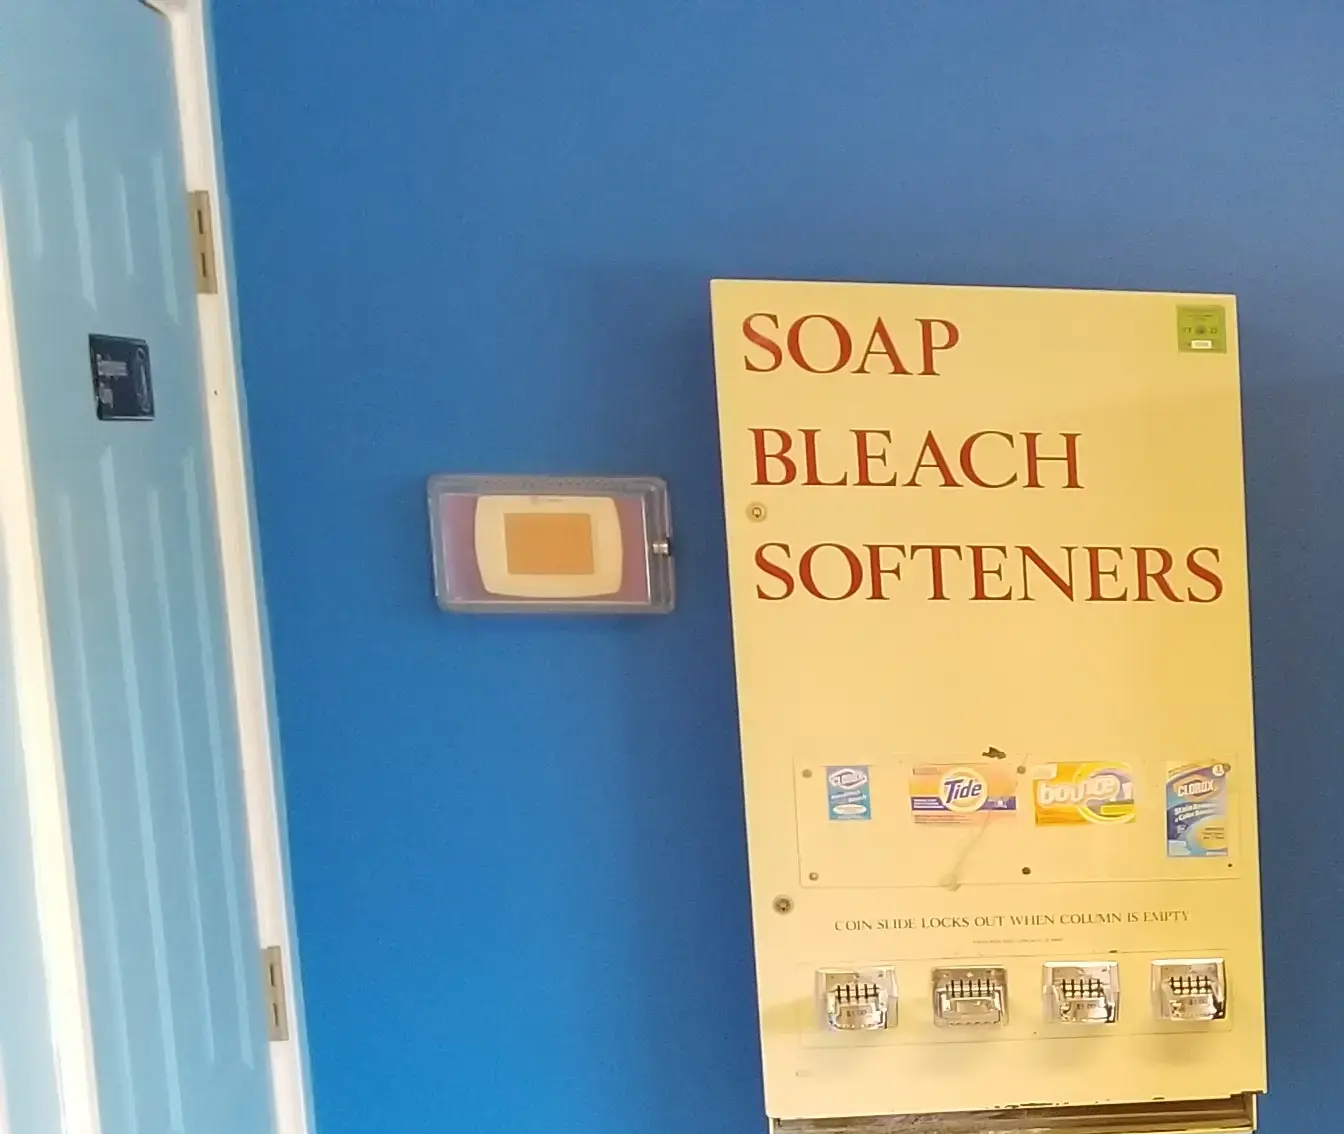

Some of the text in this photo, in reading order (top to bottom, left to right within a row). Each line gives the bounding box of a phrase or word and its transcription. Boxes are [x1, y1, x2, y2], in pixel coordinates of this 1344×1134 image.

[742, 313, 960, 377] SOAP
[747, 427, 1085, 490] BLEACH
[755, 542, 1224, 604] SOFTENERS
[944, 778, 983, 804] Tide
[1039, 774, 1115, 805] bounce
[1177, 779, 1215, 798] CLOROX
[834, 910, 1190, 931] COIN SLIDE LOCKS OUT WHEN COLUMN IS EMPTY
